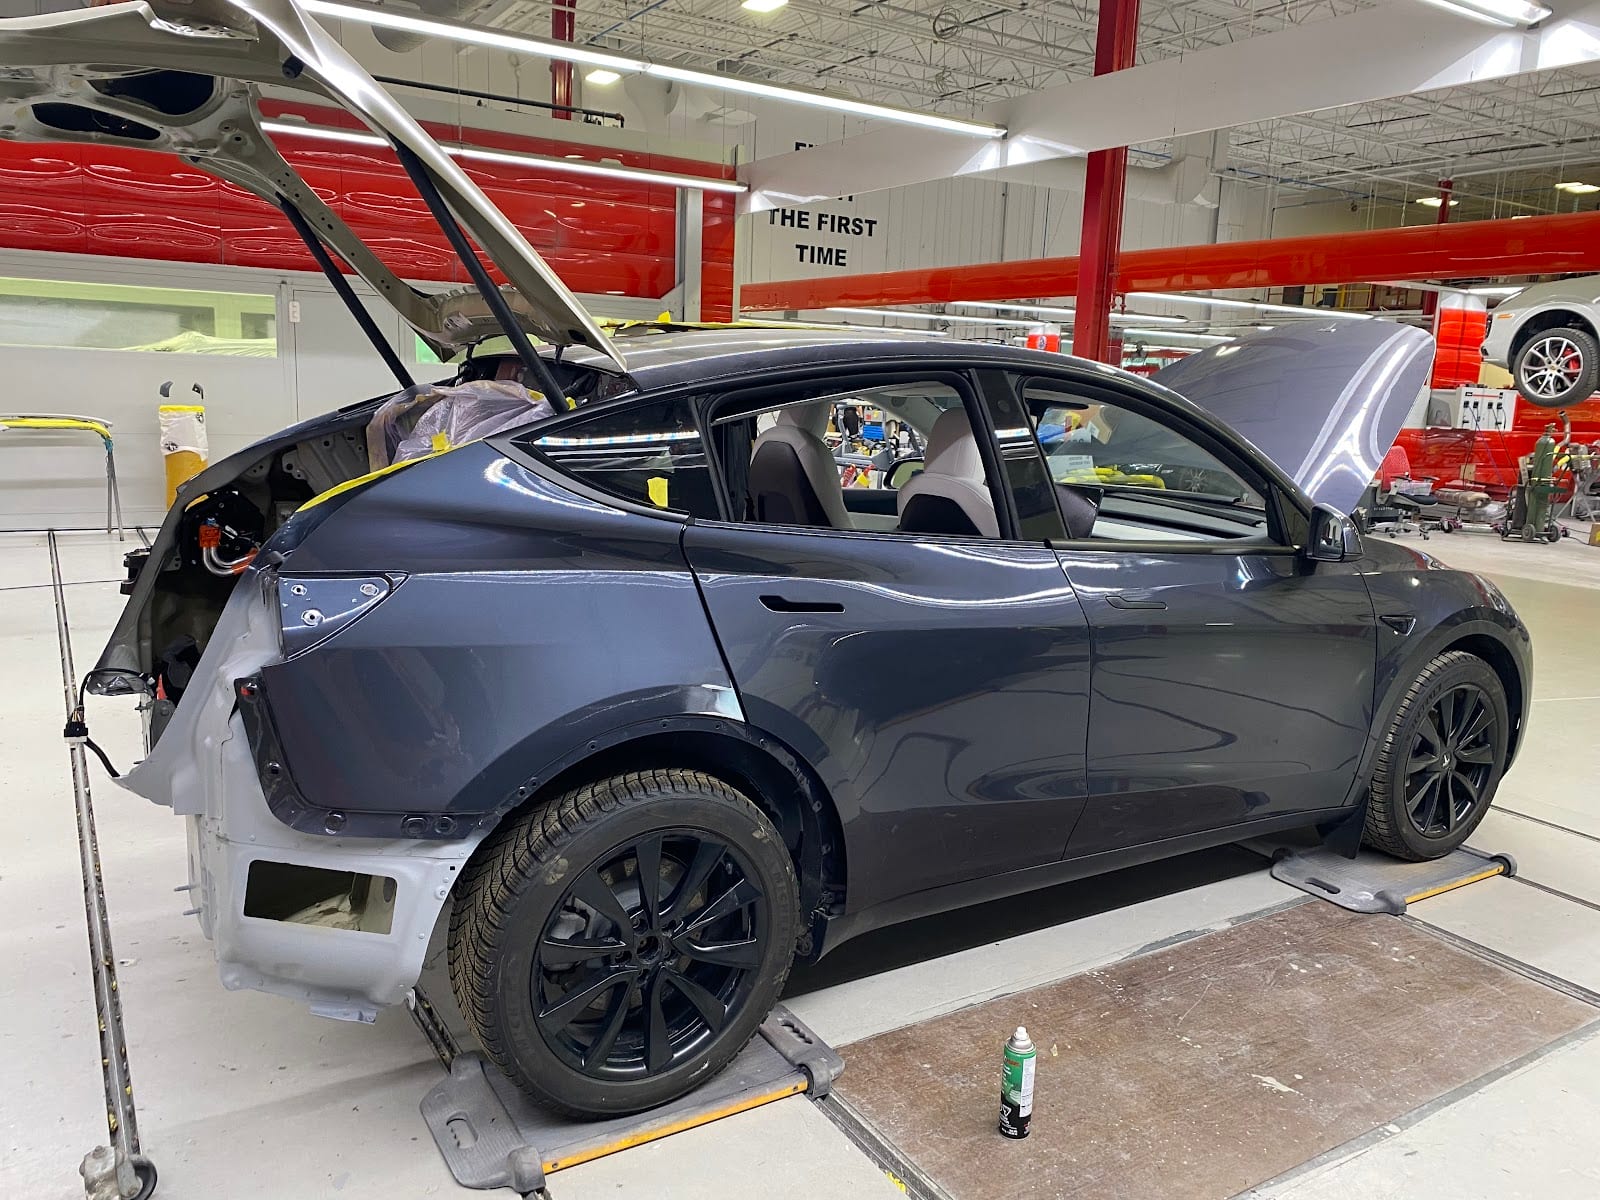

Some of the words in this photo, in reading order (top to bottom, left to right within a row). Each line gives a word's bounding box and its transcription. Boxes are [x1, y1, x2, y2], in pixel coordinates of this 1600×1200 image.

[767, 208, 810, 229] THE
[817, 213, 878, 237] FIRST
[795, 244, 847, 267] TIME
